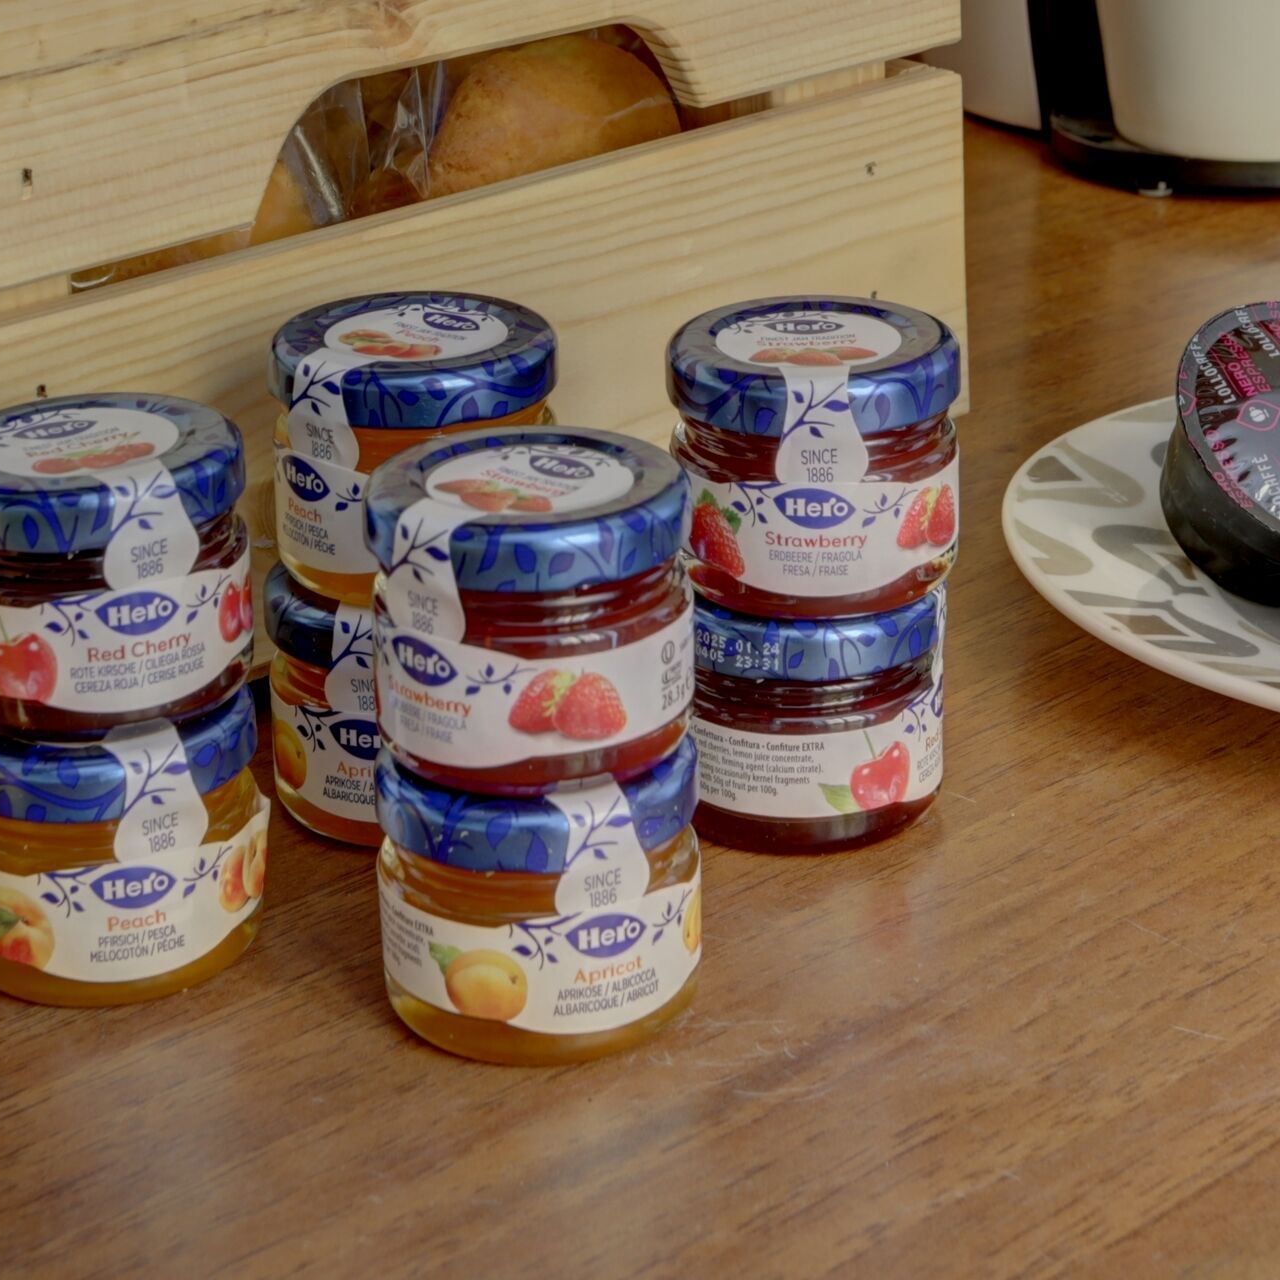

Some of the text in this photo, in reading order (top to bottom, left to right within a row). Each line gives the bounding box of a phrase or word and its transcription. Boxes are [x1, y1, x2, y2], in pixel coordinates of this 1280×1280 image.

[425, 314, 477, 330] Hero
[775, 321, 837, 332] Hero
[1228, 362, 1257, 397] NERO
[24, 420, 90, 439] Hero
[306, 422, 334, 444] SINCE
[312, 440, 332, 461] 1886
[800, 448, 838, 465] SINCE
[286, 462, 324, 494] Hero
[532, 456, 592, 480] Hero
[806, 467, 834, 483] 1886
[288, 497, 322, 524] Peach
[784, 497, 849, 517] Hero
[130, 538, 169, 563] SINCE
[765, 531, 868, 549] Strawberry
[768, 549, 862, 563] ERDBEERE FRAGOLA
[136, 560, 164, 580] 1886
[782, 564, 849, 576] FRESA FRAISE
[107, 597, 173, 628] Hero
[408, 591, 439, 617] SINCE
[86, 632, 191, 663] Red Cherry
[70, 666, 96, 680] ROTE
[98, 661, 136, 677] KIRSCHE
[398, 643, 452, 679] Hero
[735, 654, 780, 671] 23:31
[74, 656, 205, 694] CEREZA ROJA CERISE ROUGE
[351, 678, 376, 694] SINC
[388, 674, 472, 718] Strawberry
[357, 695, 376, 712] 188
[728, 735, 760, 750] Confitura
[766, 741, 801, 752] Confiture
[802, 742, 825, 751] EXTRA
[722, 756, 744, 771] firming
[746, 762, 765, 773] agent
[766, 764, 795, 775] (calcium
[733, 748, 753, 760] lemon
[754, 752, 770, 763] juice
[771, 754, 815, 763] concentrate,
[325, 774, 362, 791] APRIKOSE
[724, 778, 732, 787] of
[732, 780, 746, 791] fruit
[747, 783, 759, 793] per
[752, 771, 773, 783] kernel
[774, 775, 811, 787] fragments
[142, 811, 179, 836] SINCE
[148, 831, 176, 853] 1886
[102, 872, 170, 900] Hero
[584, 868, 622, 891] SINCE
[590, 887, 618, 908] 1886
[107, 910, 166, 932] Peach
[98, 924, 177, 948] PFIRSICH PESCA
[577, 918, 641, 951] Hero
[574, 956, 643, 985] Apricot
[557, 968, 657, 1002] APRIKOSE ALBICOCCA
[553, 979, 660, 1017] ALBARICOQUE ABRICOT
